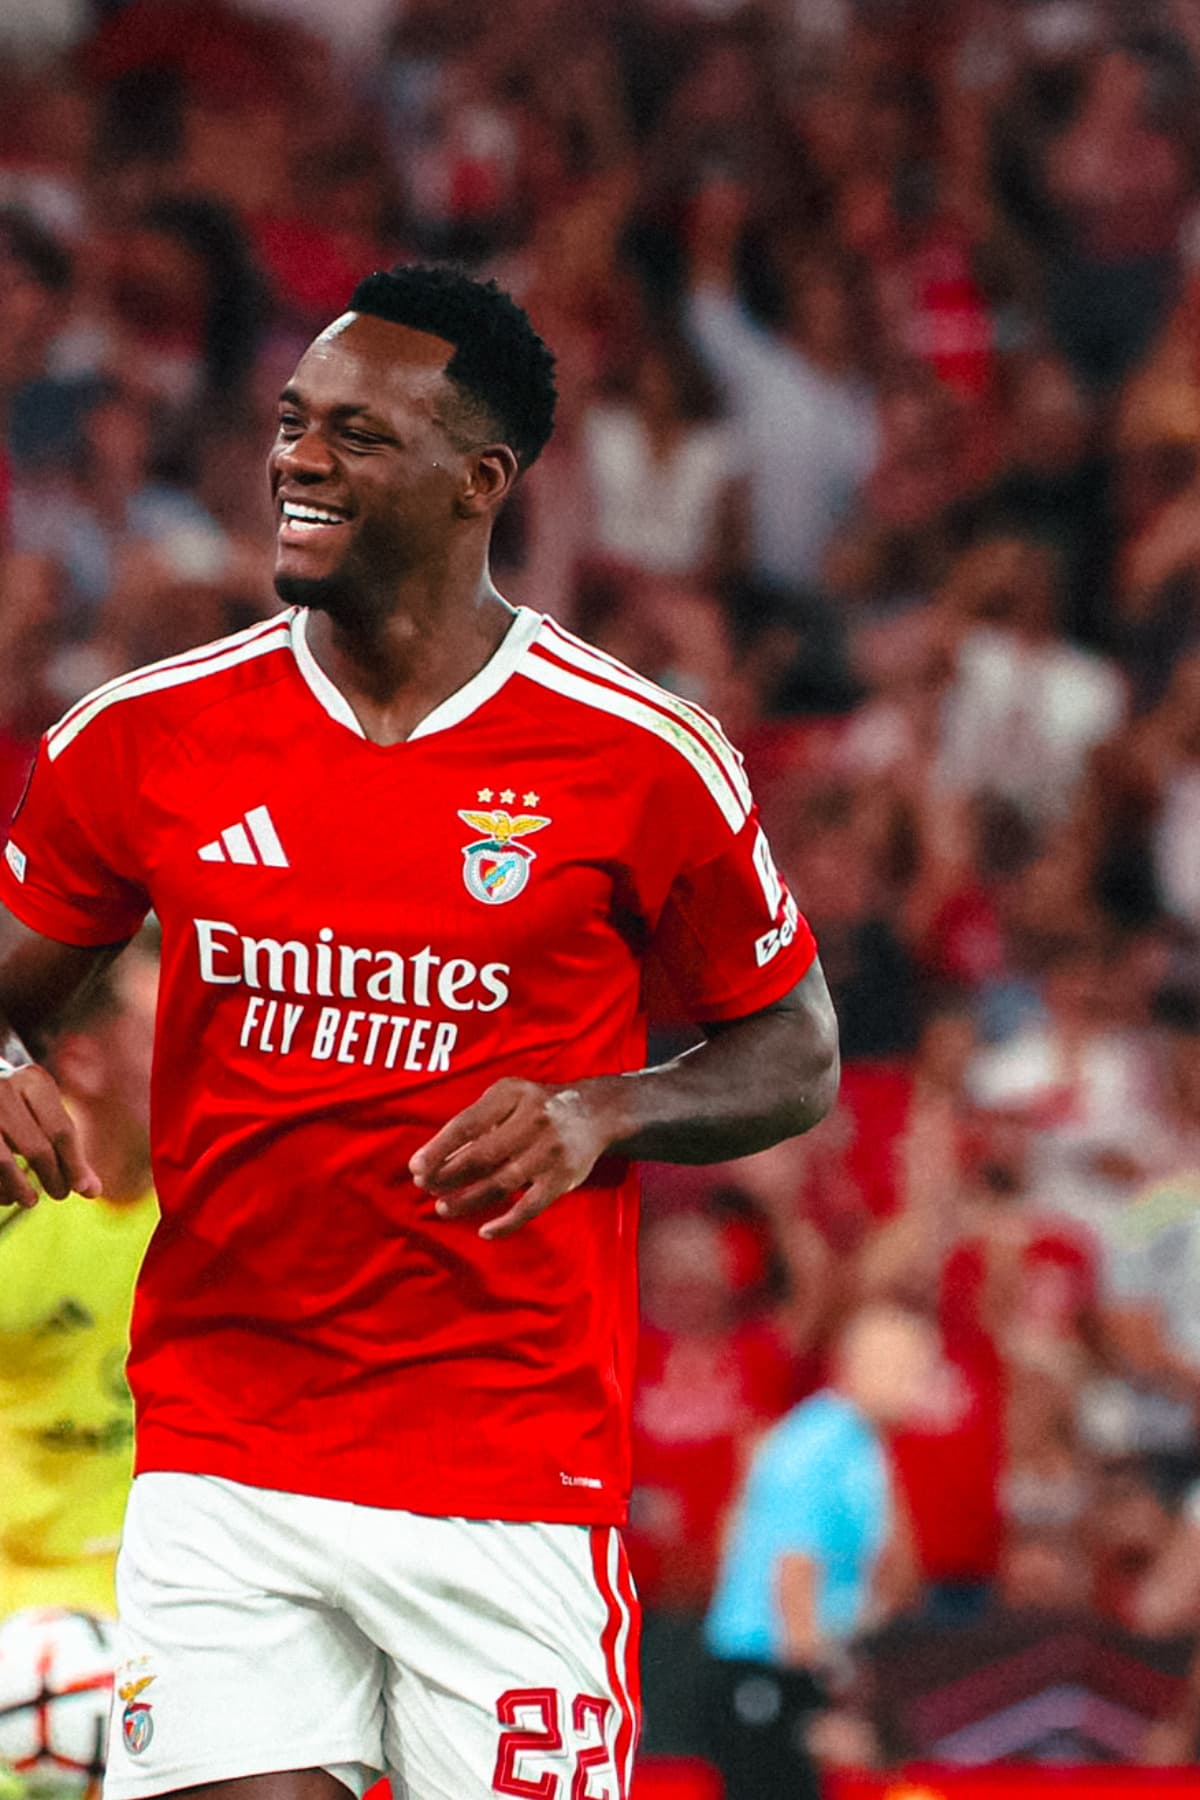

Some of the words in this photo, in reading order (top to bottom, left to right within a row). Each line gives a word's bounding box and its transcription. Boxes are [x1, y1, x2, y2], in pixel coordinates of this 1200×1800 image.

[193, 918, 510, 1012] Emirates
[239, 996, 305, 1055] FLY
[311, 1006, 458, 1073] BETTER
[492, 1687, 612, 1800] 22
